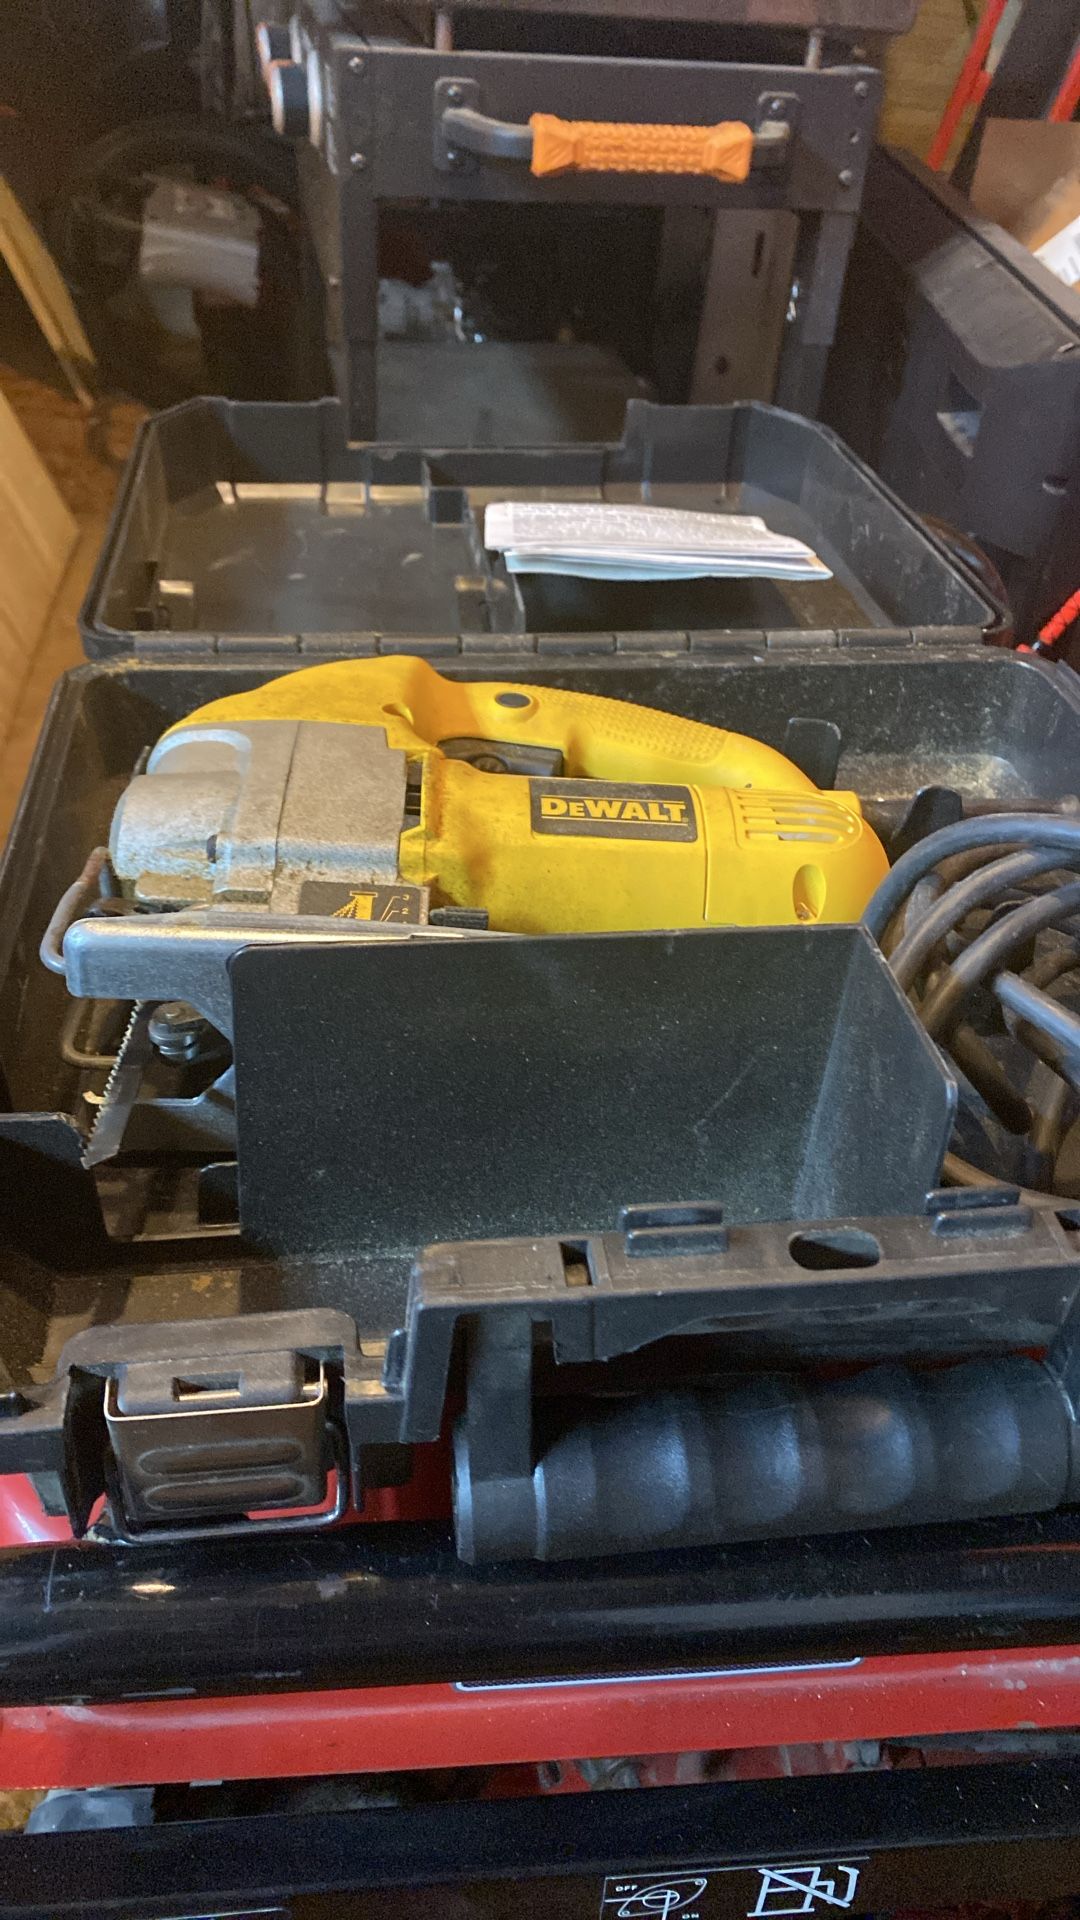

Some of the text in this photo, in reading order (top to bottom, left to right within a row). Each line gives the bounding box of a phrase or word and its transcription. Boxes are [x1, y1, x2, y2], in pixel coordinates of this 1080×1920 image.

[402, 893, 410, 901] 3
[401, 907, 409, 915] 2
[615, 1884, 638, 1892] OFF
